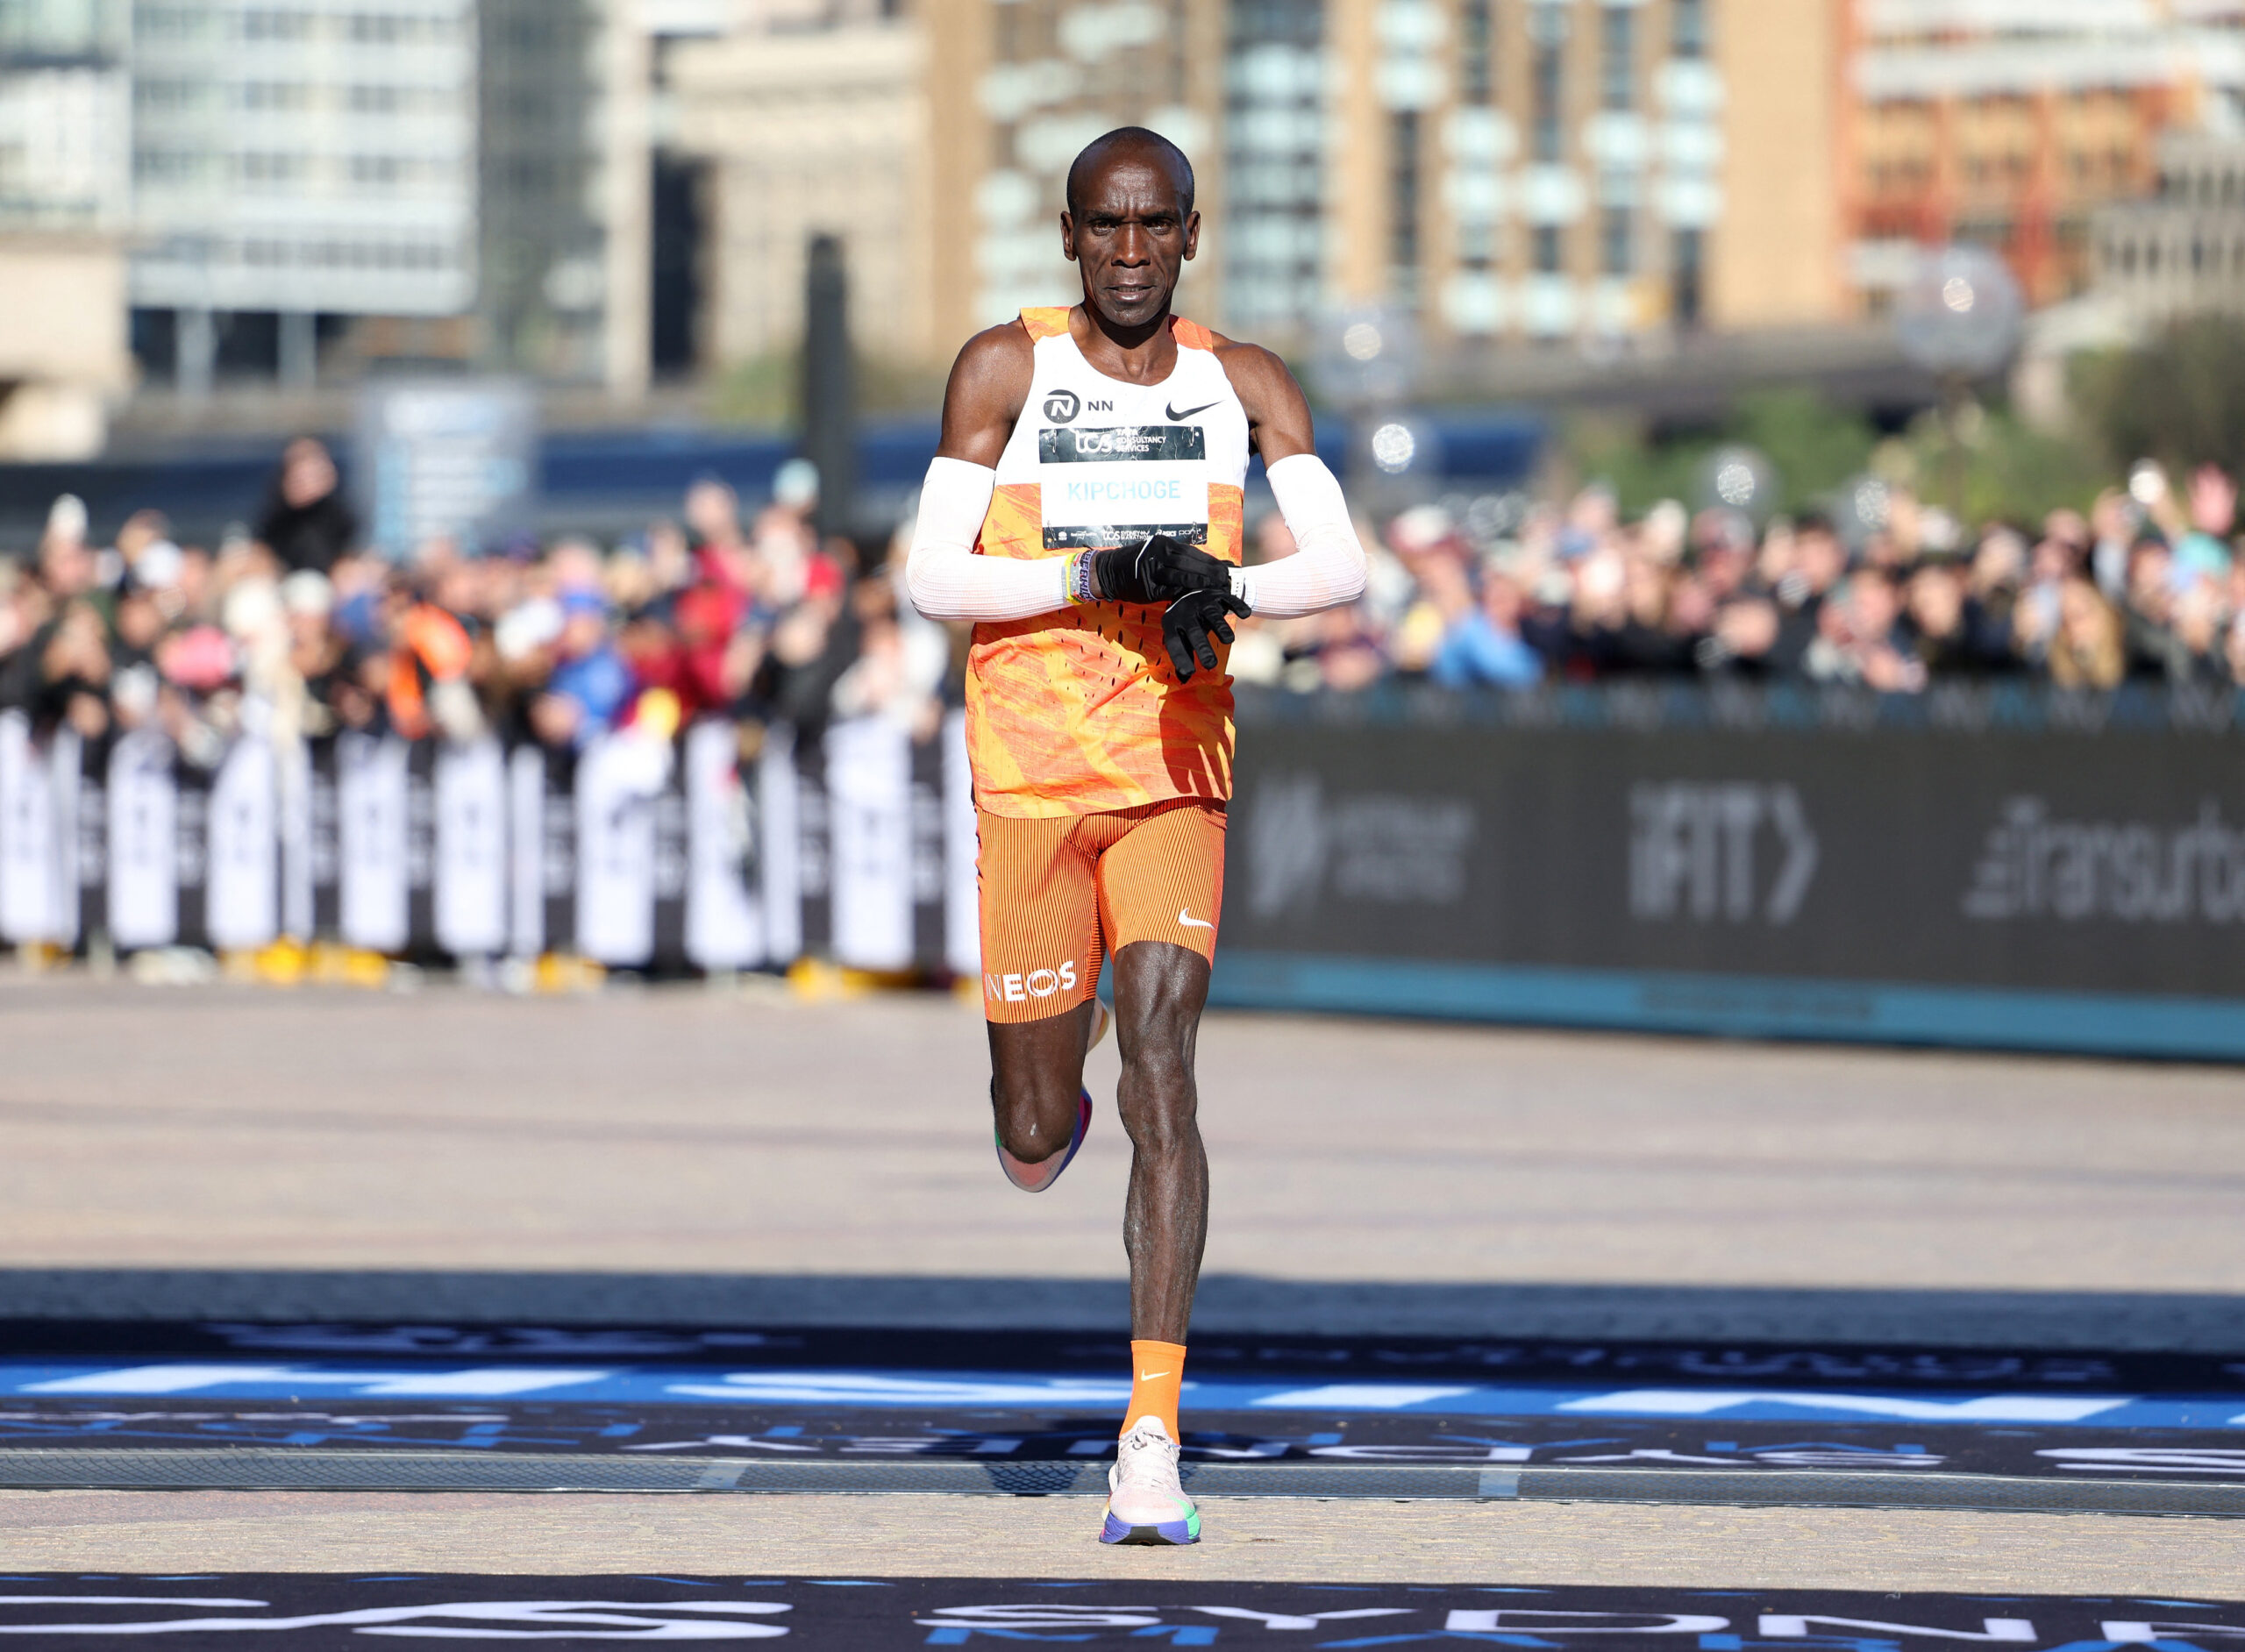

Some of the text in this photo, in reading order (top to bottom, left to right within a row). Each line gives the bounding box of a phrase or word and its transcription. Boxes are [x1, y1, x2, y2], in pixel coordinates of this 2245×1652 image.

[1087, 400, 1114, 412] NN
[1116, 436, 1167, 445] CONSULTANCY
[1116, 444, 1150, 452] SERVICES
[1068, 480, 1180, 501] KIPCHOGE
[2005, 795, 2245, 921] Transurb
